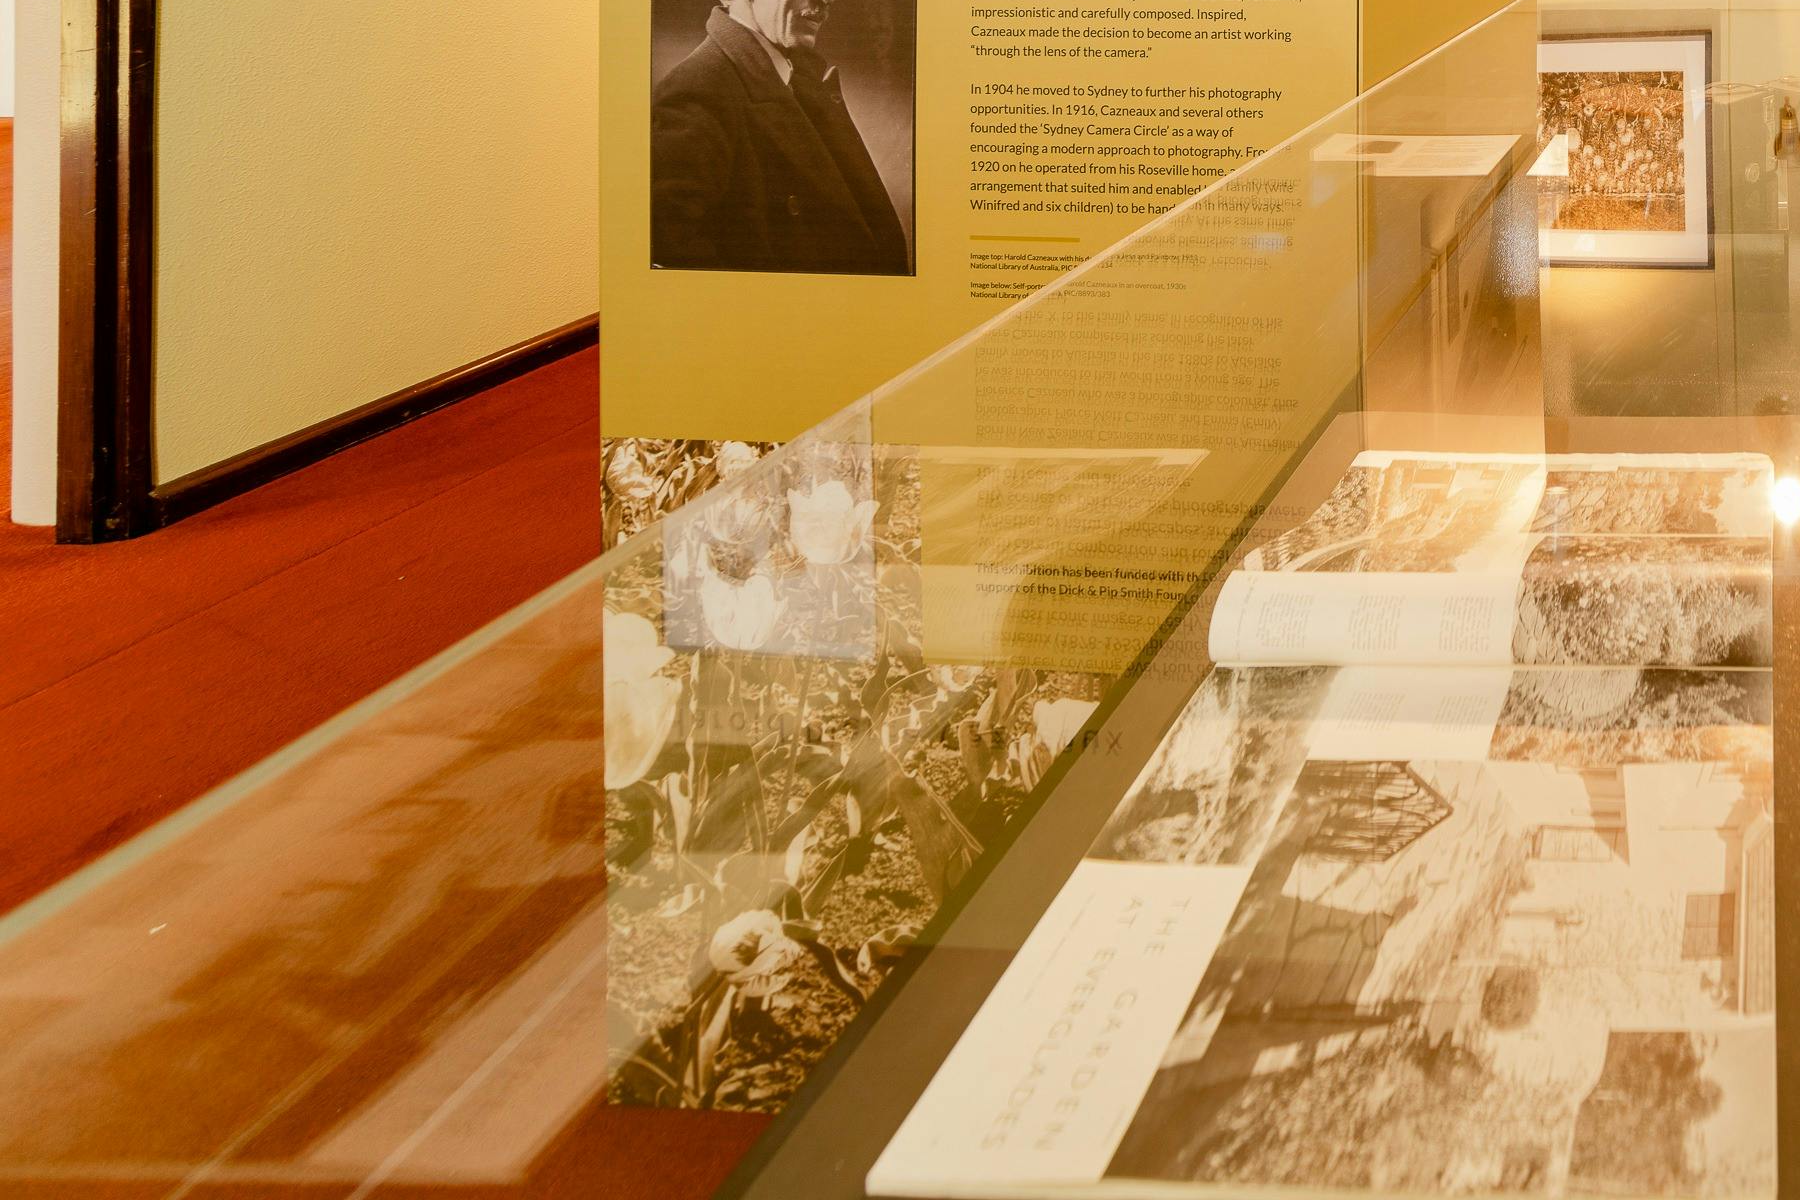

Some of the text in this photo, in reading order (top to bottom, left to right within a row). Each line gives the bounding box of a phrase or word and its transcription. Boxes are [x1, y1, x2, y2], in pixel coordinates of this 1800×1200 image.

[971, 83, 1282, 101] In 1904 he moved to Sydney to further his photography
[970, 103, 1264, 119] opportunities. In 1916, Cazneaux and several others
[970, 252, 990, 261] Image
[1004, 253, 1026, 261] Harold
[1026, 254, 1058, 262] Cazneaux
[1059, 254, 1074, 262] with
[1075, 254, 1084, 263] his
[970, 262, 997, 270] National
[998, 263, 1021, 271] Library
[1029, 263, 1060, 272] Australia,
[970, 281, 990, 290] Image
[970, 290, 997, 299] National
[998, 291, 1021, 300] Library
[975, 562, 999, 575] This
[1002, 564, 1059, 577] exhibition
[1063, 566, 1082, 578] has
[1085, 566, 1112, 578] been
[1115, 567, 1155, 581] funded
[1158, 570, 1183, 582] with
[1023, 582, 1035, 594] of
[1037, 582, 1056, 595] the
[1059, 584, 1084, 596] Dick
[1088, 586, 1097, 597] &
[1100, 586, 1117, 599] Pip
[1120, 586, 1153, 599] Smith
[1143, 896, 1192, 957] THE
[981, 948, 1116, 1151] EVERGLADES
[1033, 989, 1138, 1151] GARDEN
